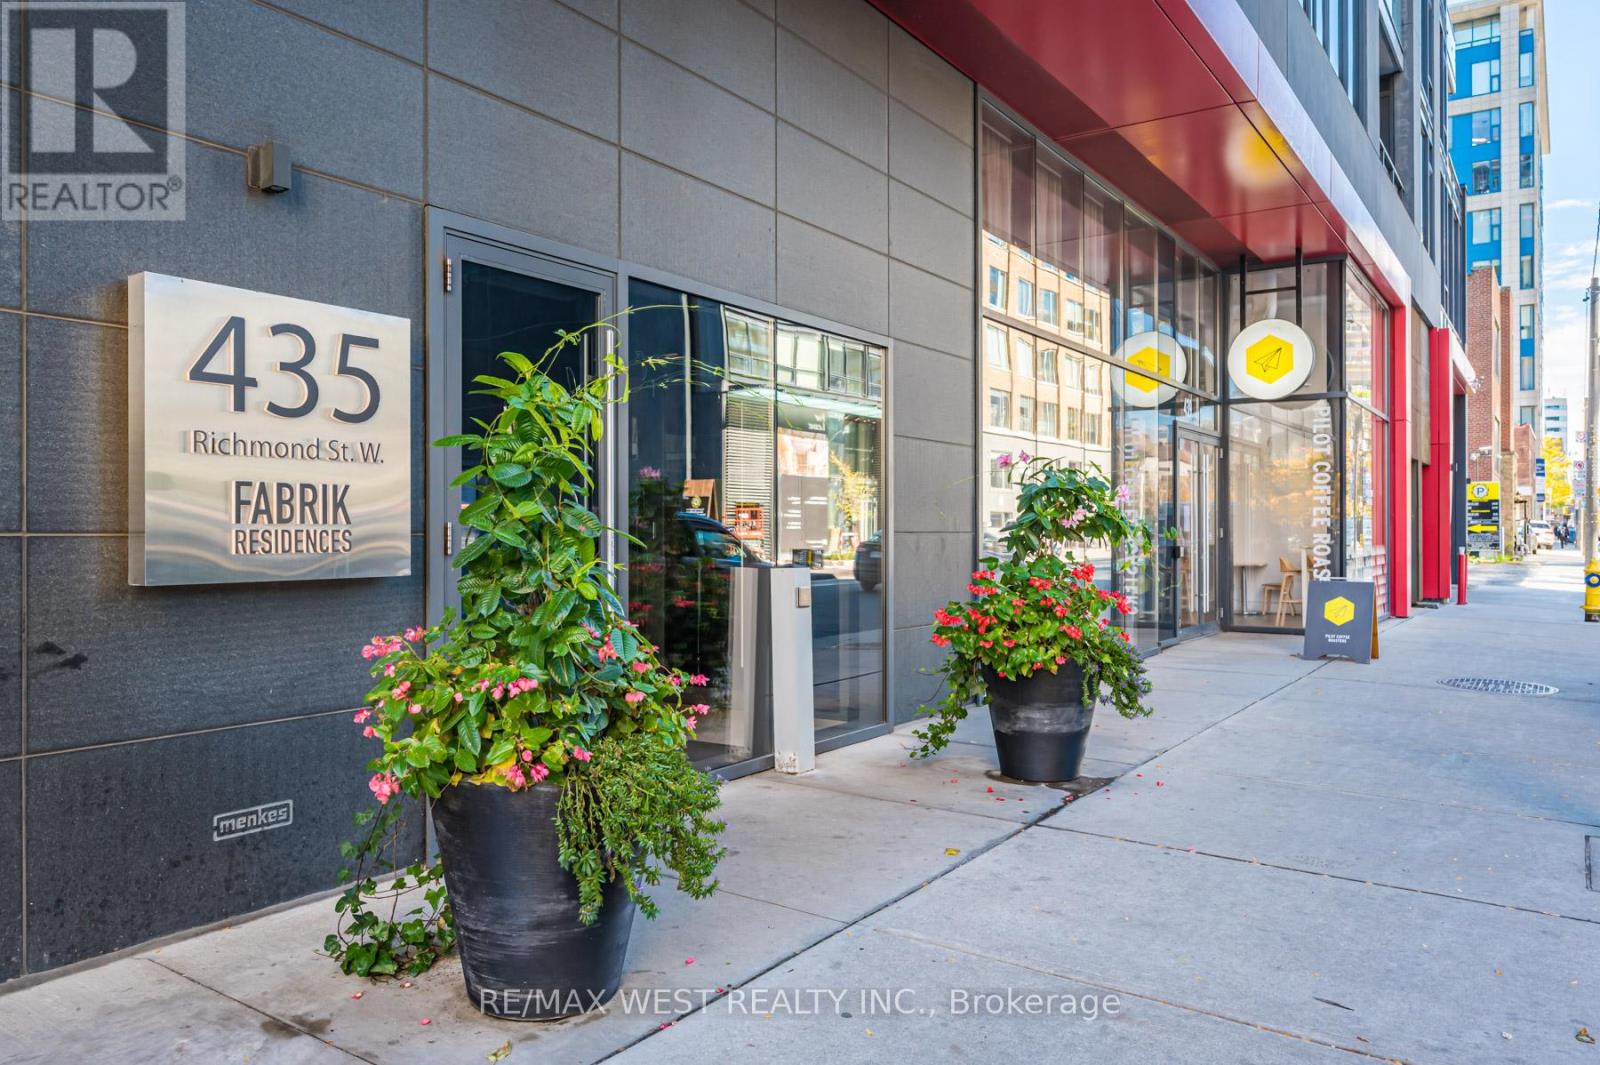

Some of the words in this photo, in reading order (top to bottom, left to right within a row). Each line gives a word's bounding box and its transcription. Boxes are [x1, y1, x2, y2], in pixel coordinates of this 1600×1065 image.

[187, 315, 381, 424] 435
[192, 430, 320, 461] Richmond
[328, 439, 354, 462] St.
[359, 441, 384, 464] W.
[1312, 404, 1331, 455] PILOT
[232, 480, 352, 525] FABRIK
[1312, 461, 1331, 527] COFFEE
[232, 528, 352, 555] RESIDENCES
[1312, 533, 1331, 581] ROAS
[219, 806, 288, 834] menkes
